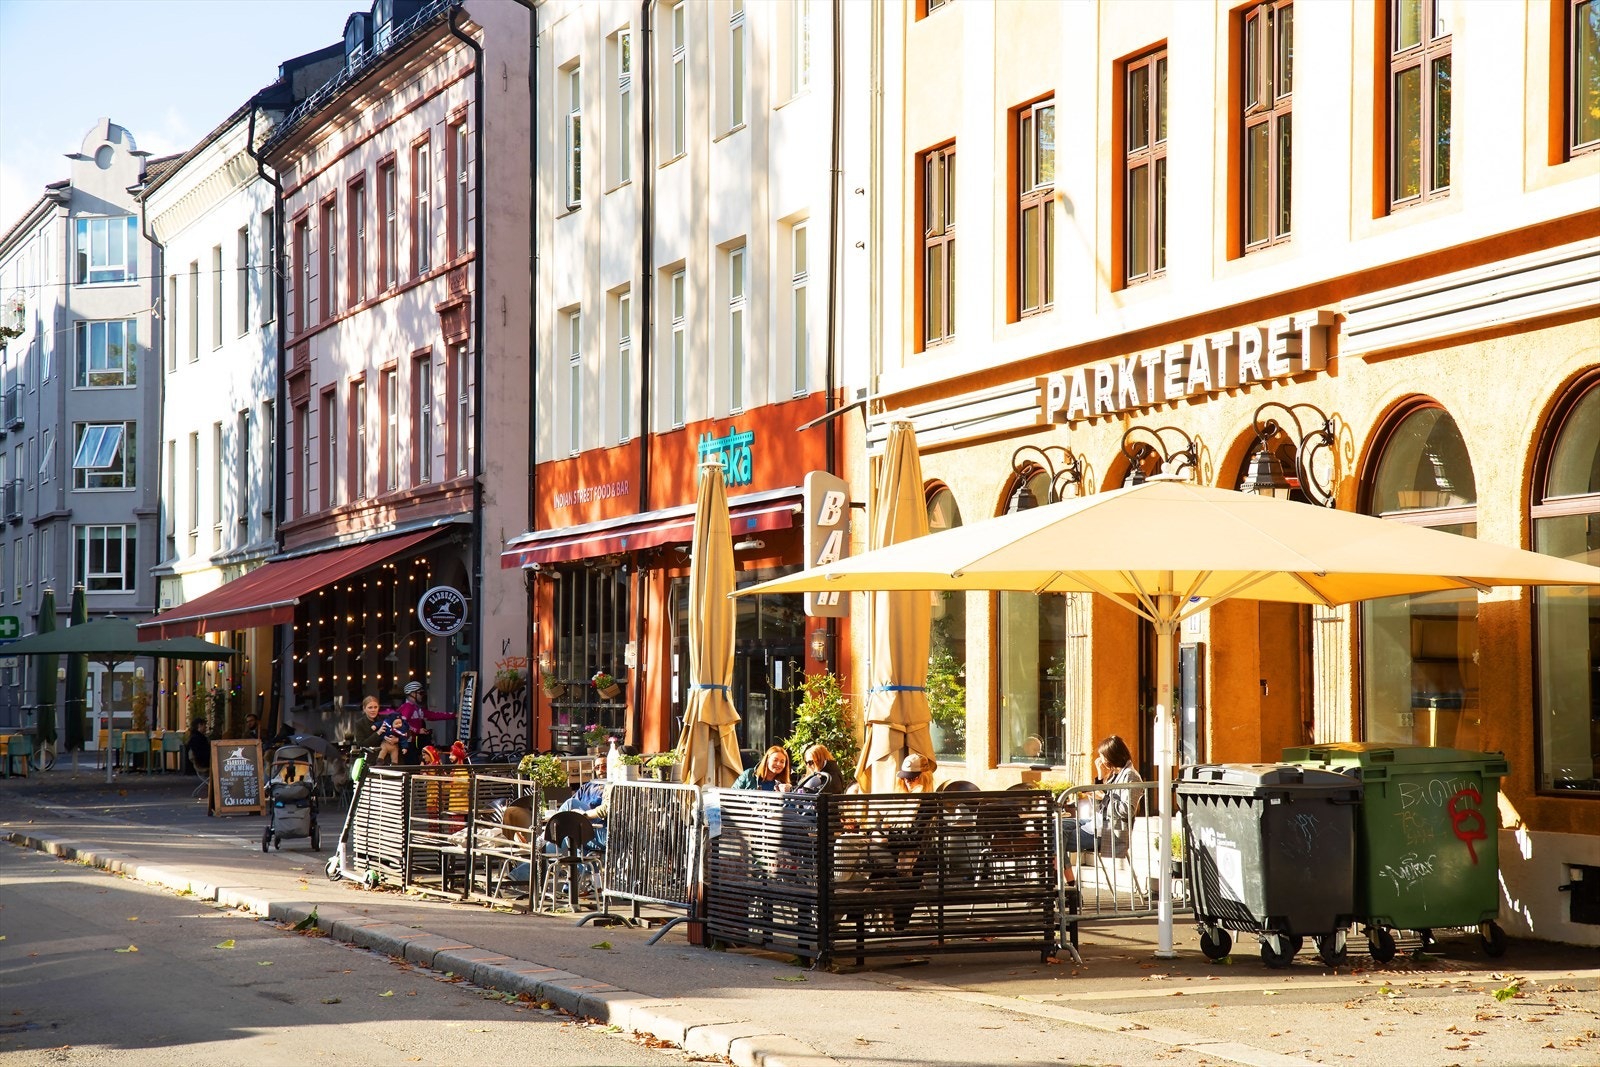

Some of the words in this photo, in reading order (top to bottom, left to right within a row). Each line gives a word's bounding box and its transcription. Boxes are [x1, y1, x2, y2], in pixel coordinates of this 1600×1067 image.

[1047, 310, 1319, 423] PARKTEATRET
[553, 491, 573, 509] INDIAN
[573, 487, 594, 505] STREET
[593, 484, 611, 501] FOOD
[611, 483, 616, 498] &
[616, 480, 630, 496] BAR
